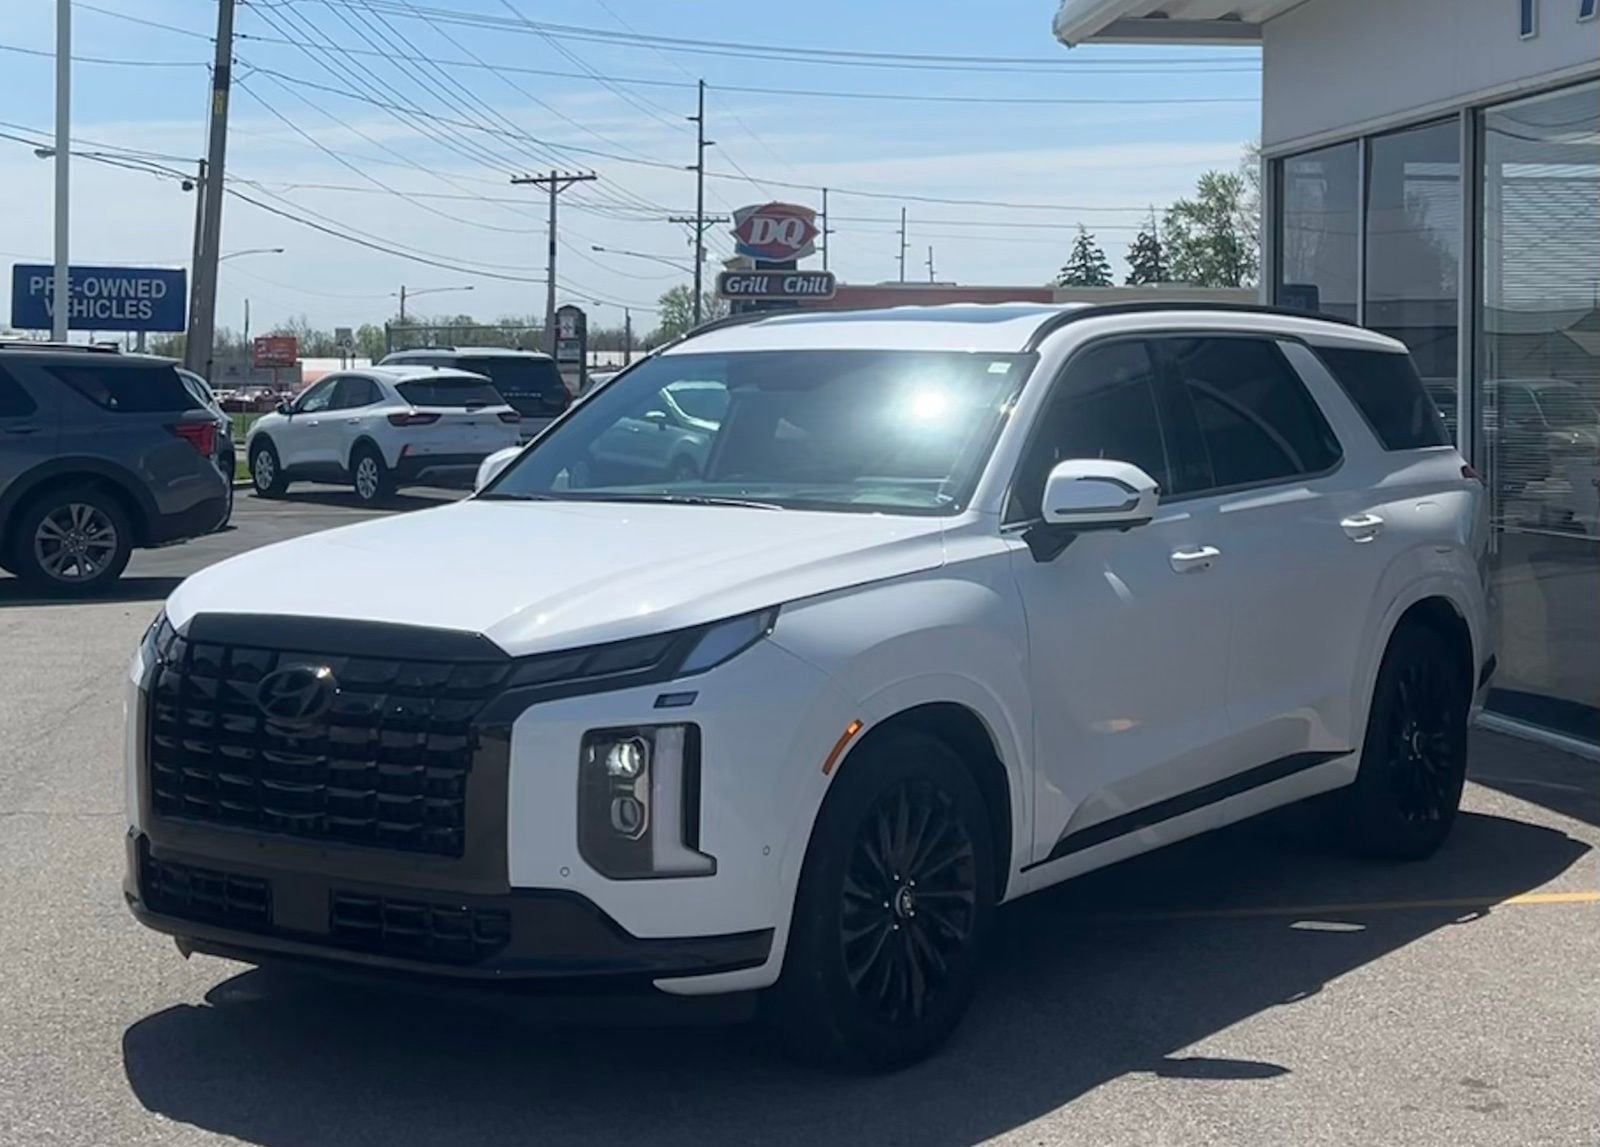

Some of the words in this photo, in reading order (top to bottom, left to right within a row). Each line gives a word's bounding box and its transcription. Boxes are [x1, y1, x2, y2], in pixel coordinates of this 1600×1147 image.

[748, 218, 805, 249] DQ
[726, 276, 769, 293] Grill
[783, 276, 828, 293] Chill
[44, 297, 153, 319] VHICLES
